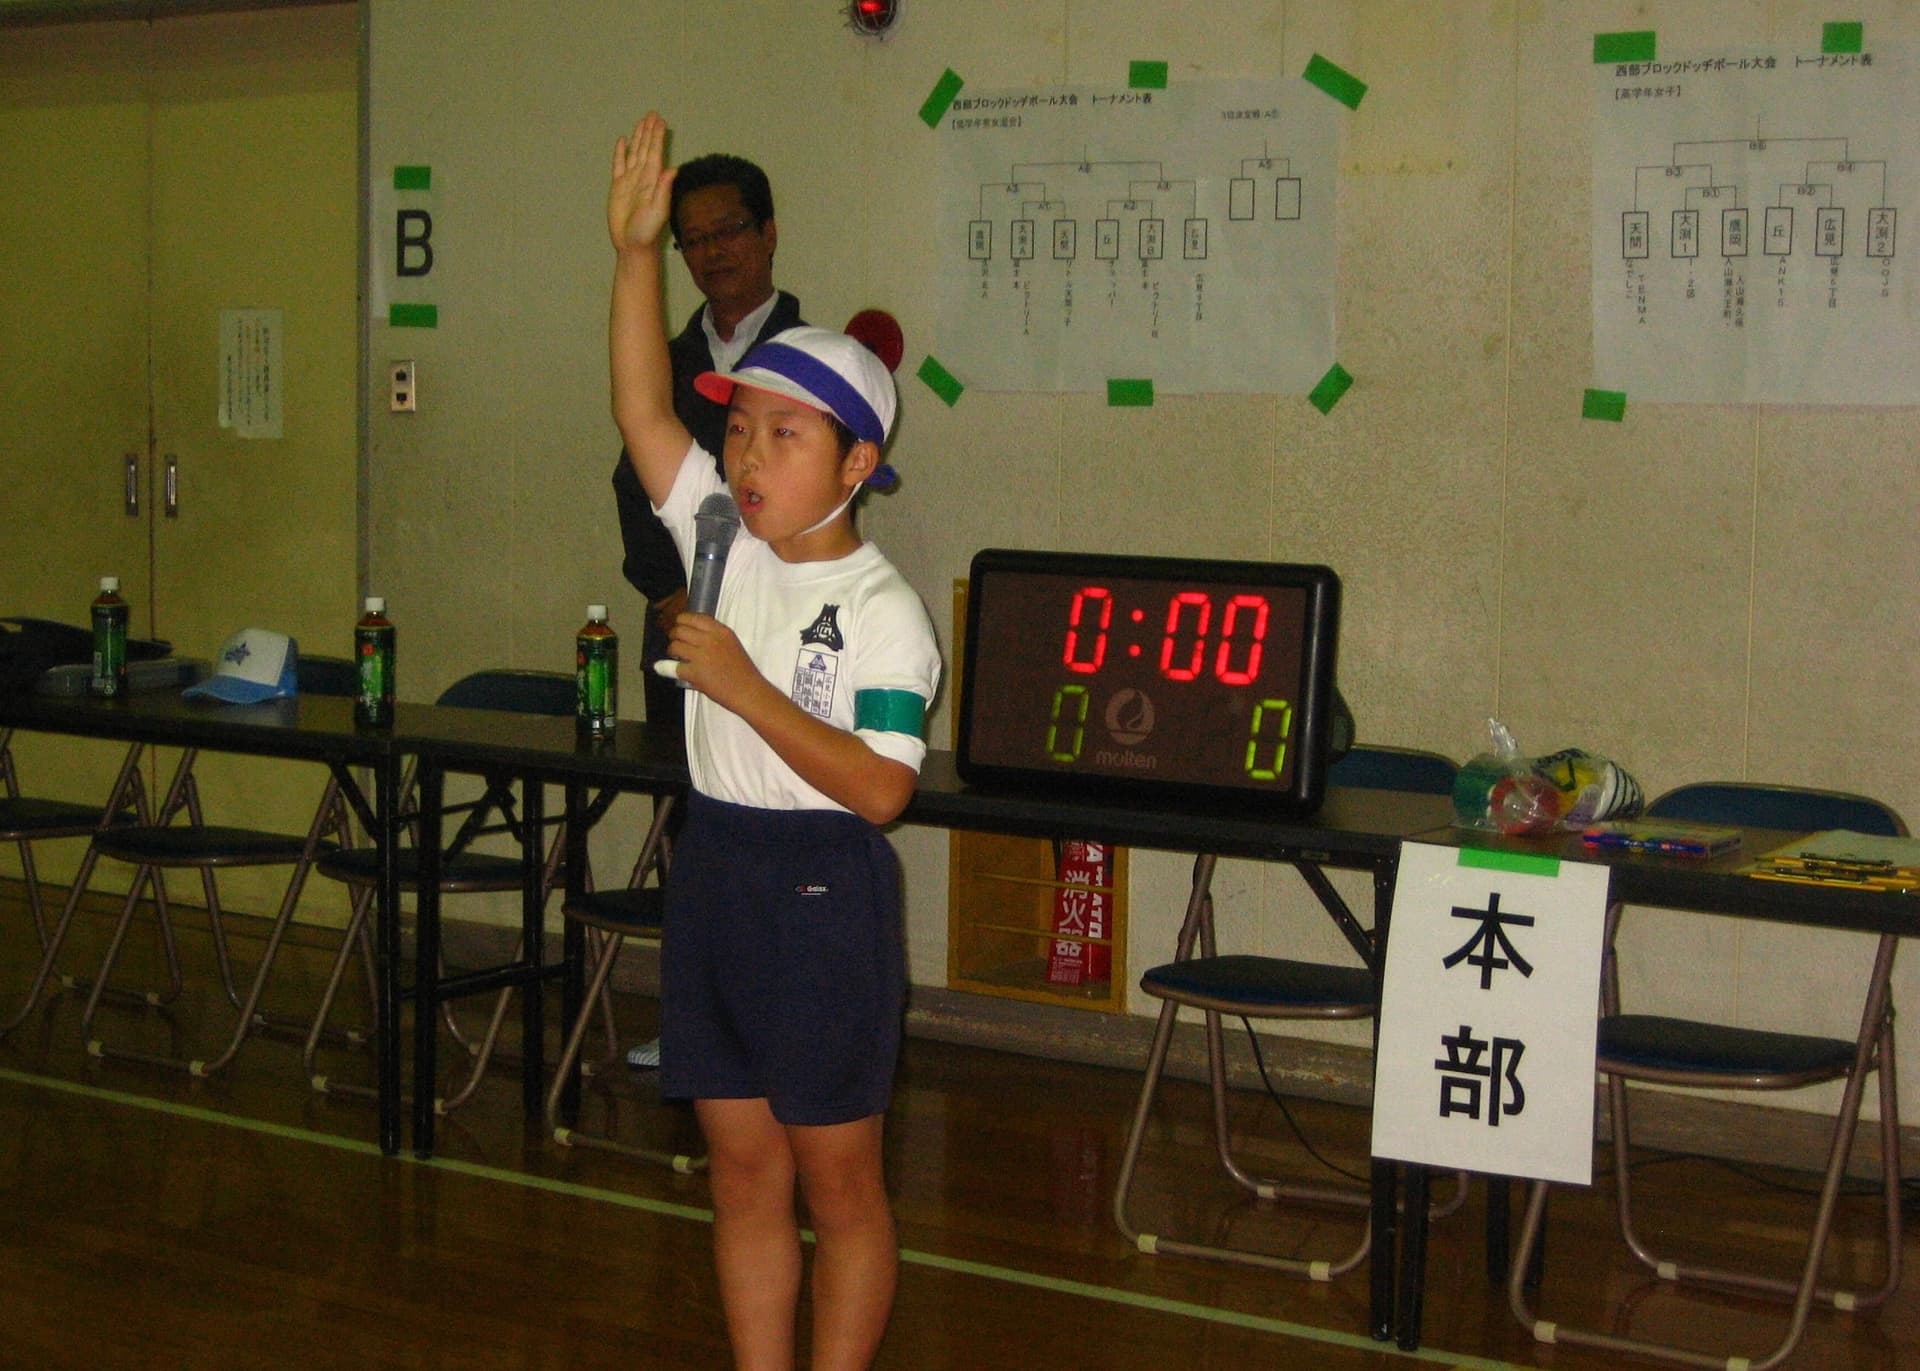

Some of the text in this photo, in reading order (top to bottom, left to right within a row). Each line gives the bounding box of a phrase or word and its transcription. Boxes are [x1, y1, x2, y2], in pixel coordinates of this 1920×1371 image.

[1795, 53, 1873, 69] トーナメント表
[397, 209, 433, 277] B
[1063, 586, 1270, 686] 0:00
[1045, 684, 1292, 781] 0 0
[1095, 749, 1158, 770] molten
[1055, 869, 1090, 958] 消火器
[1434, 892, 1535, 1127] 本部
